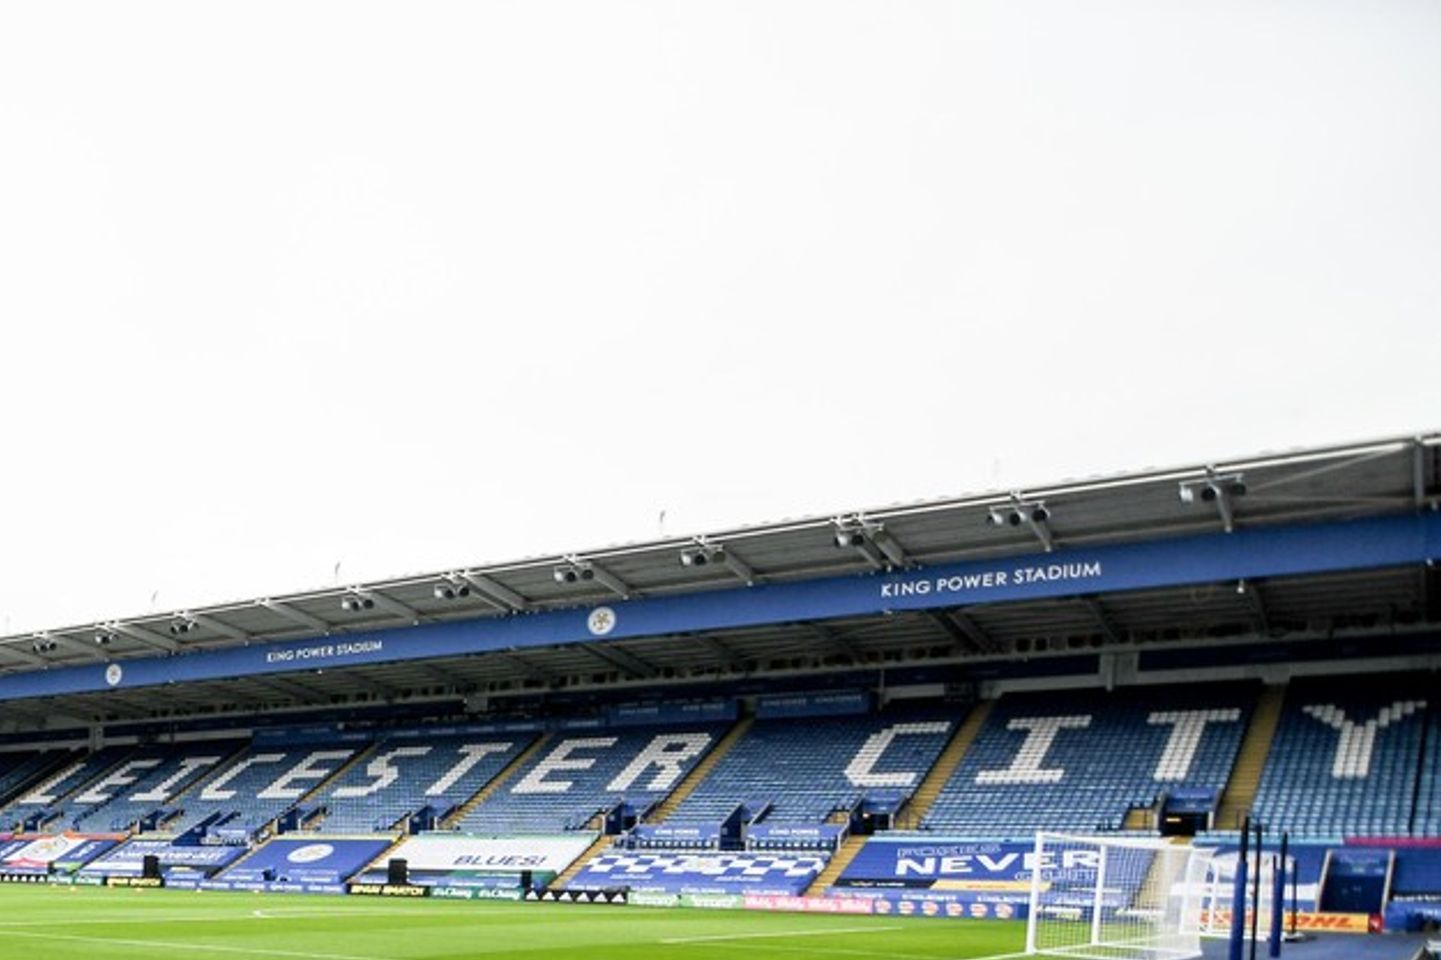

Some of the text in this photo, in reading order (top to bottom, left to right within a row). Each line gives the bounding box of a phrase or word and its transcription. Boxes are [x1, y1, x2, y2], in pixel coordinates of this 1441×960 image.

[880, 561, 1102, 597] KING POWER STADIUM
[267, 640, 382, 662] KING POWER STADIUM
[20, 699, 1428, 803] LEICESTER CITY
[453, 855, 547, 866] BLUES!
[894, 850, 1100, 876] NEVER
